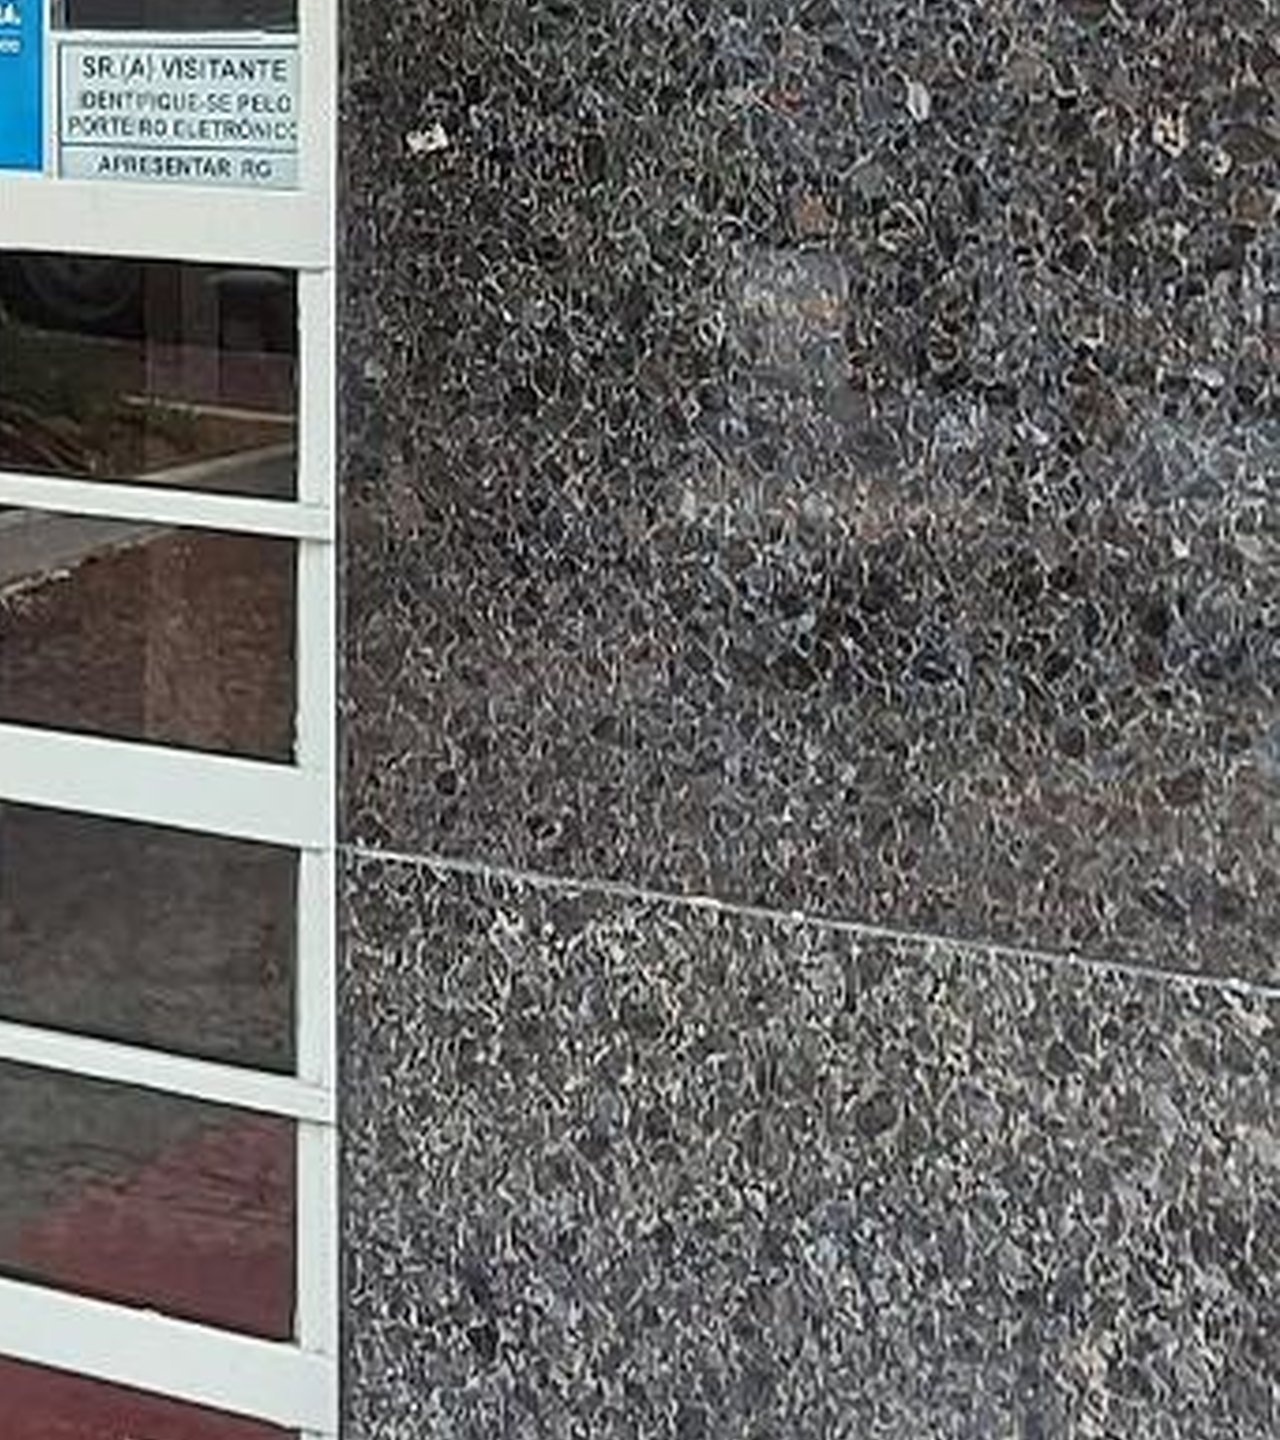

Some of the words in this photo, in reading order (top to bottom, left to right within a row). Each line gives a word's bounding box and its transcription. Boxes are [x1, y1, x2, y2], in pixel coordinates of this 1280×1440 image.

[160, 56, 287, 82] VISITANTE
[237, 93, 291, 114] PELO
[68, 115, 168, 137] PORTEIRO
[97, 155, 232, 177] APRESENTAR
[241, 158, 272, 178] RG
